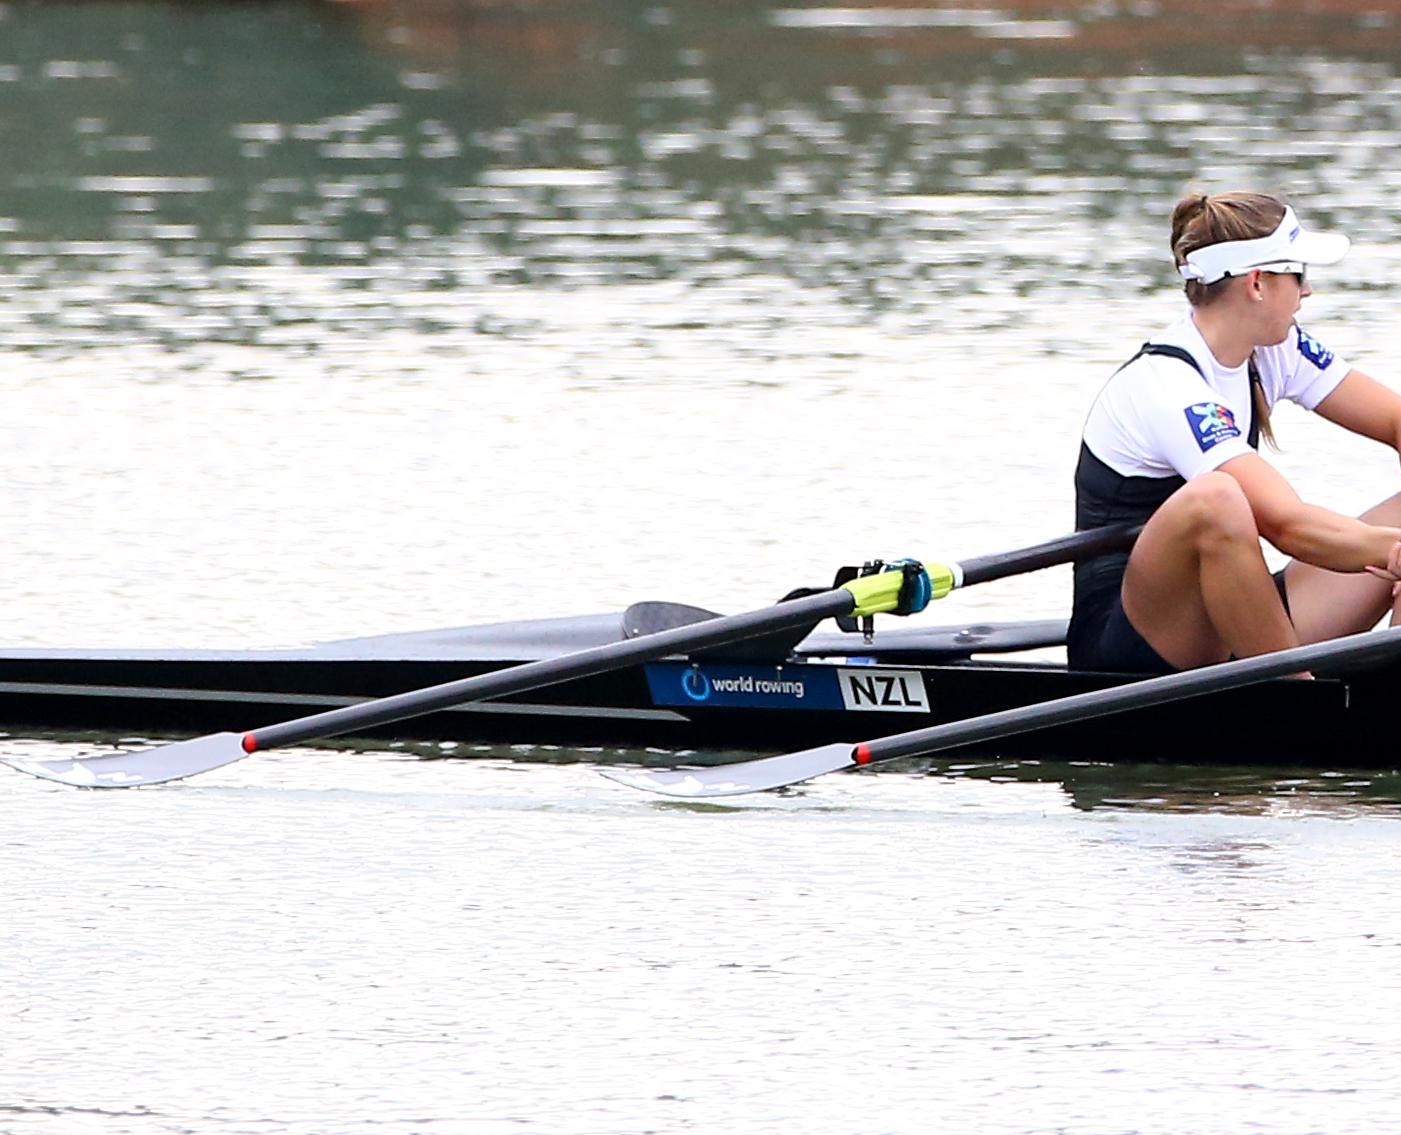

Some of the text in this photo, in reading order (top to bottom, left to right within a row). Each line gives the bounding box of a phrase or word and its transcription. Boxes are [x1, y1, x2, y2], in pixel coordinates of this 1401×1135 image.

[712, 676, 804, 698] world rowing
[848, 675, 923, 707] NZL
